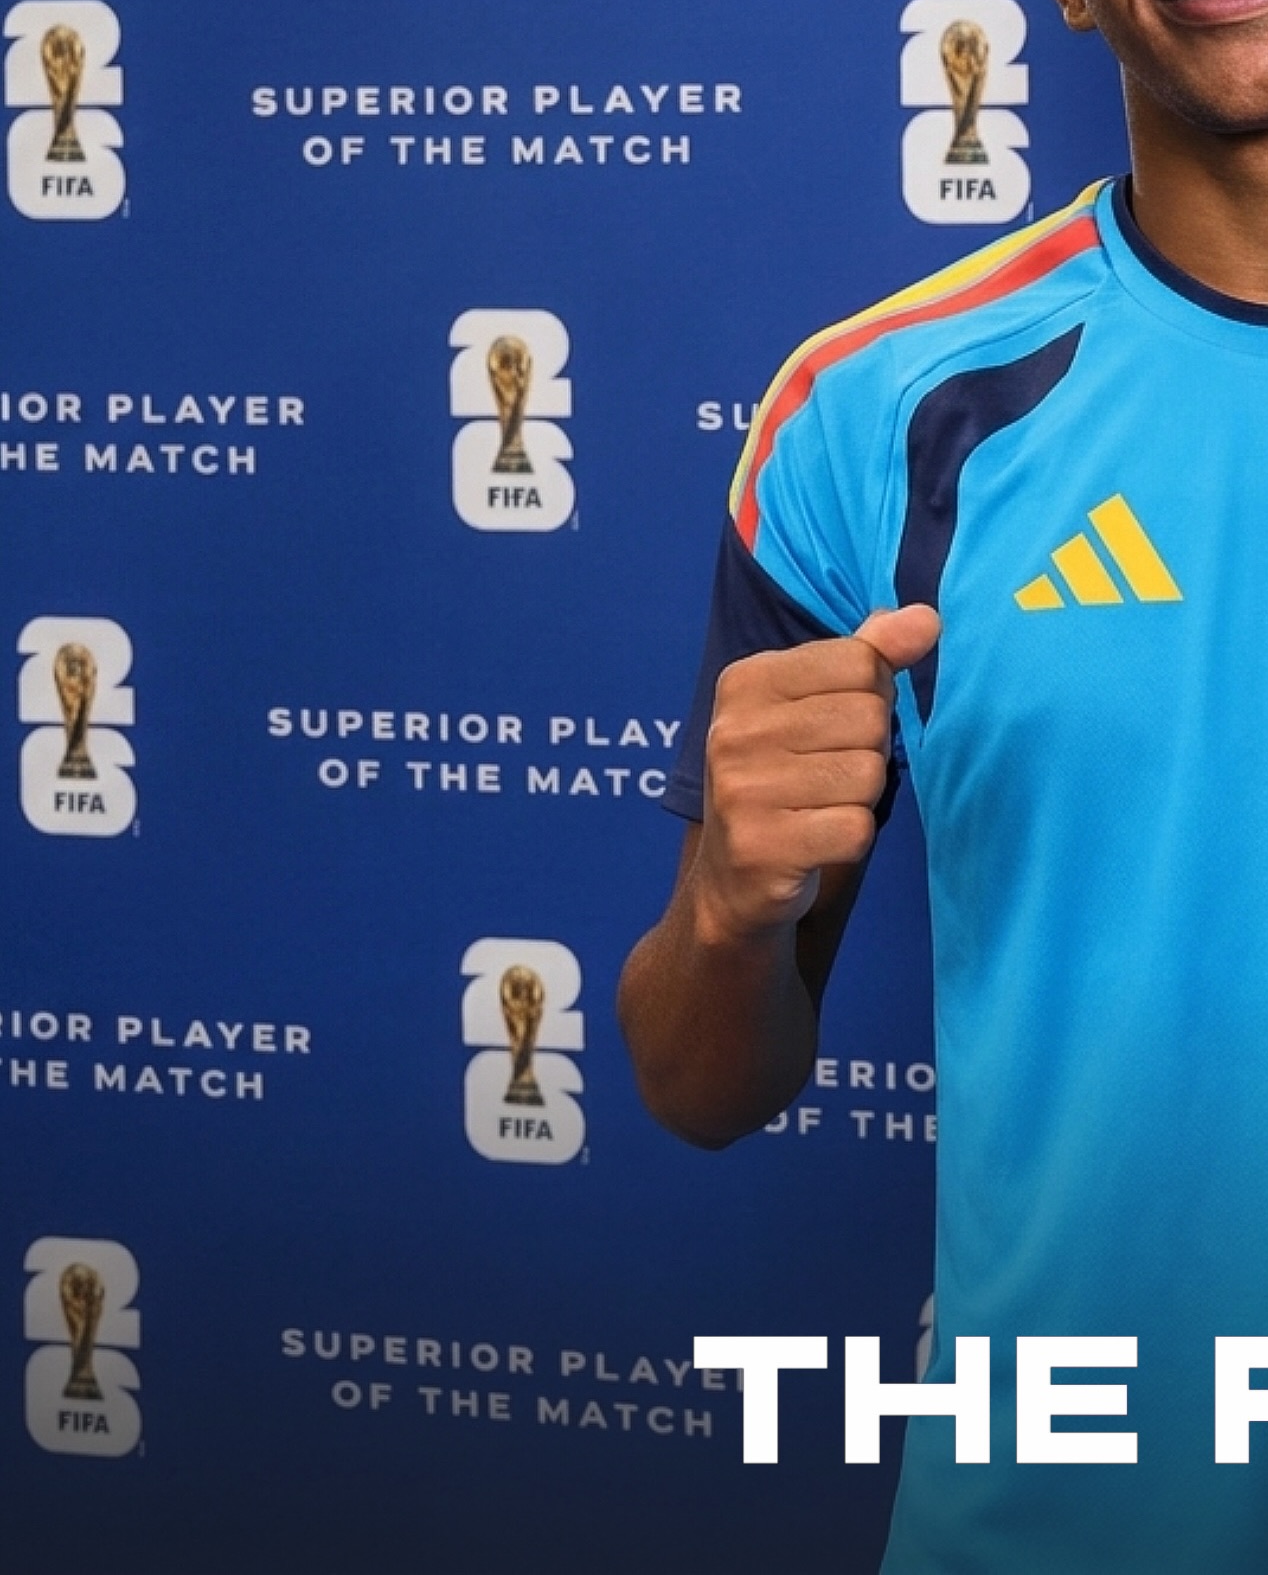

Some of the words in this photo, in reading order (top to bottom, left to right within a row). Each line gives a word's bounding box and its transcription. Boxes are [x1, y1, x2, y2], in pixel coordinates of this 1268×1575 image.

[253, 86, 507, 115] SUPERIOR
[535, 85, 740, 113] PLAYER
[303, 137, 363, 165] OF
[391, 137, 484, 164] THE
[513, 136, 689, 163] MATCH
[940, 178, 996, 200] FIFA
[109, 395, 303, 424] PLAYER
[0, 443, 59, 471] HE
[85, 444, 254, 474] MATCH
[269, 708, 521, 743] SUPERIOR
[551, 717, 680, 747] PLAY
[319, 759, 379, 787] OF
[407, 762, 500, 791] THE
[528, 767, 665, 797] MATC
[54, 792, 106, 814] FIFA
[118, 1017, 310, 1053] PLAYER
[0, 1058, 69, 1088] HE
[95, 1064, 262, 1098] MATCH
[499, 1117, 553, 1140] FIFA
[282, 1329, 533, 1373] SUPERIOR
[58, 1410, 110, 1434] FIFA
[332, 1381, 391, 1409] OF
[419, 1387, 510, 1419] THE
[538, 1397, 711, 1436] MATCH
